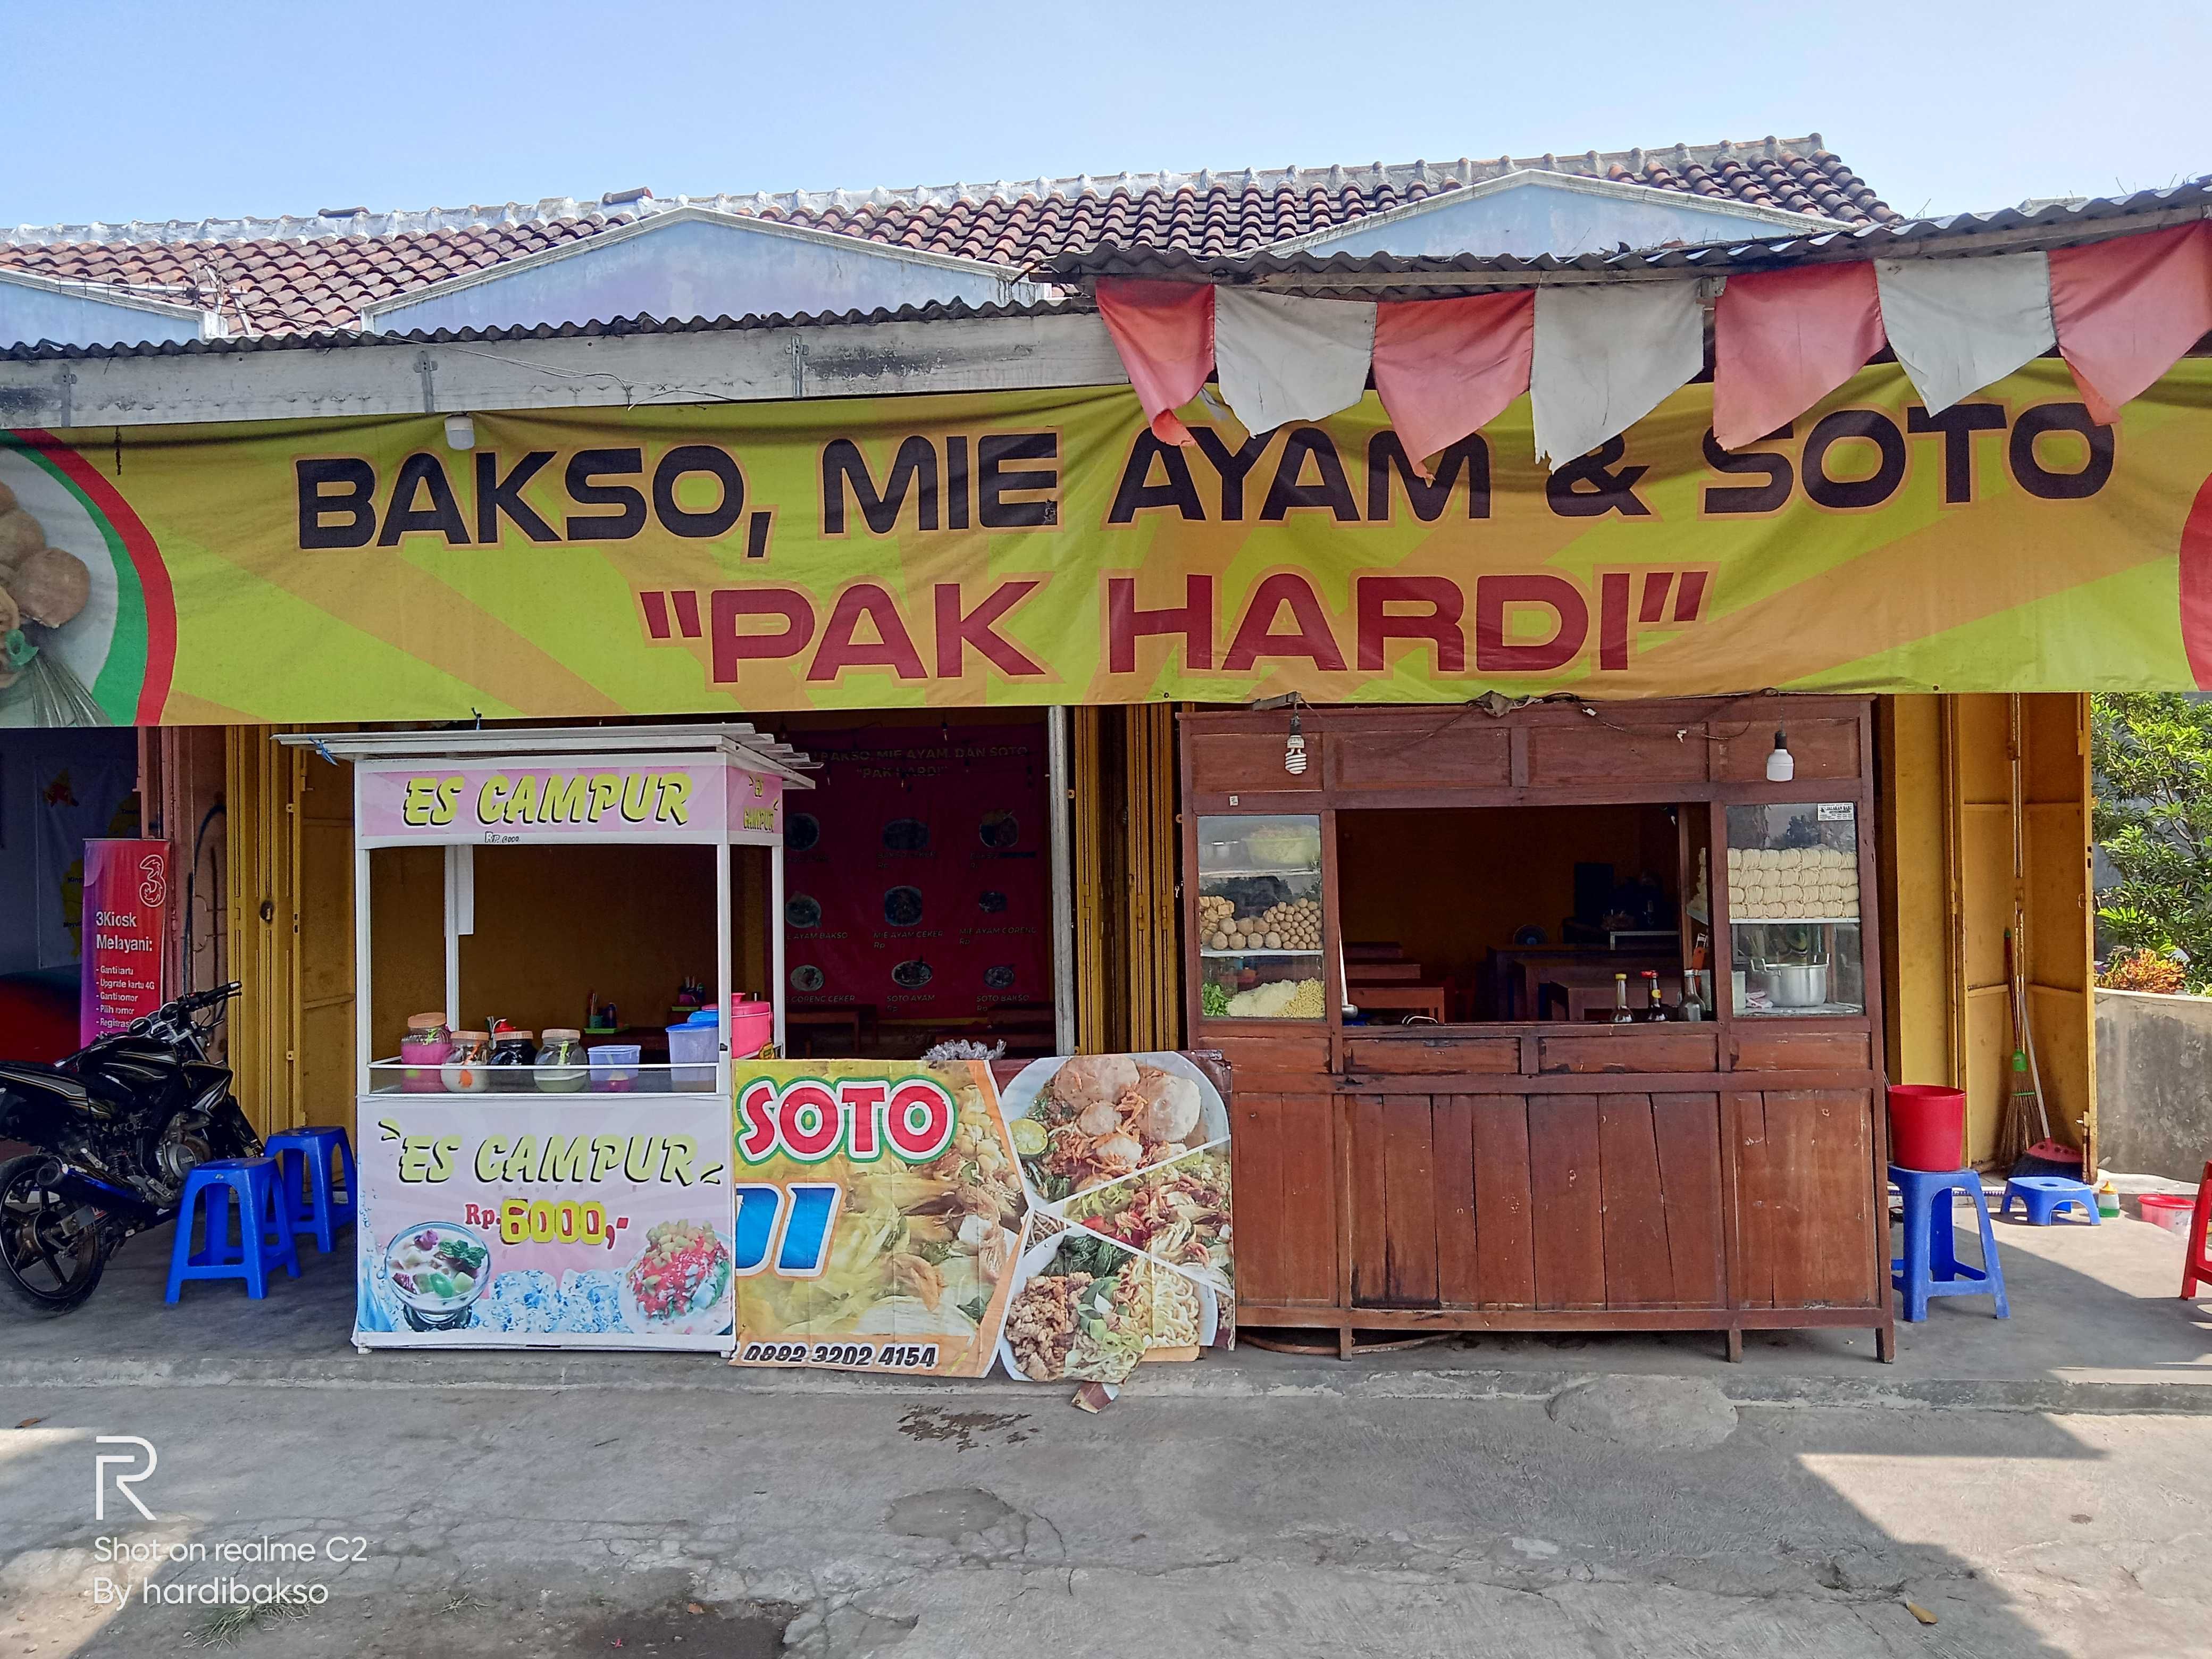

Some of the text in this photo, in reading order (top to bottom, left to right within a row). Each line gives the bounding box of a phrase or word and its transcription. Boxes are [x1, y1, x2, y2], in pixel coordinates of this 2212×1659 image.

[296, 403, 2114, 558] BAKSO, MIE AYAM & SOTO
[640, 571, 1708, 683] "PAK HARDI"
[403, 772, 692, 826] ES CAMPUR
[96, 911, 137, 927] 3Kiosk
[96, 934, 153, 953] Melayani:
[741, 1082, 953, 1160] SOTO
[398, 1134, 699, 1187] ES CAMPUR
[811, 1345, 873, 1366] 3202
[878, 1347, 936, 1367] 4154
